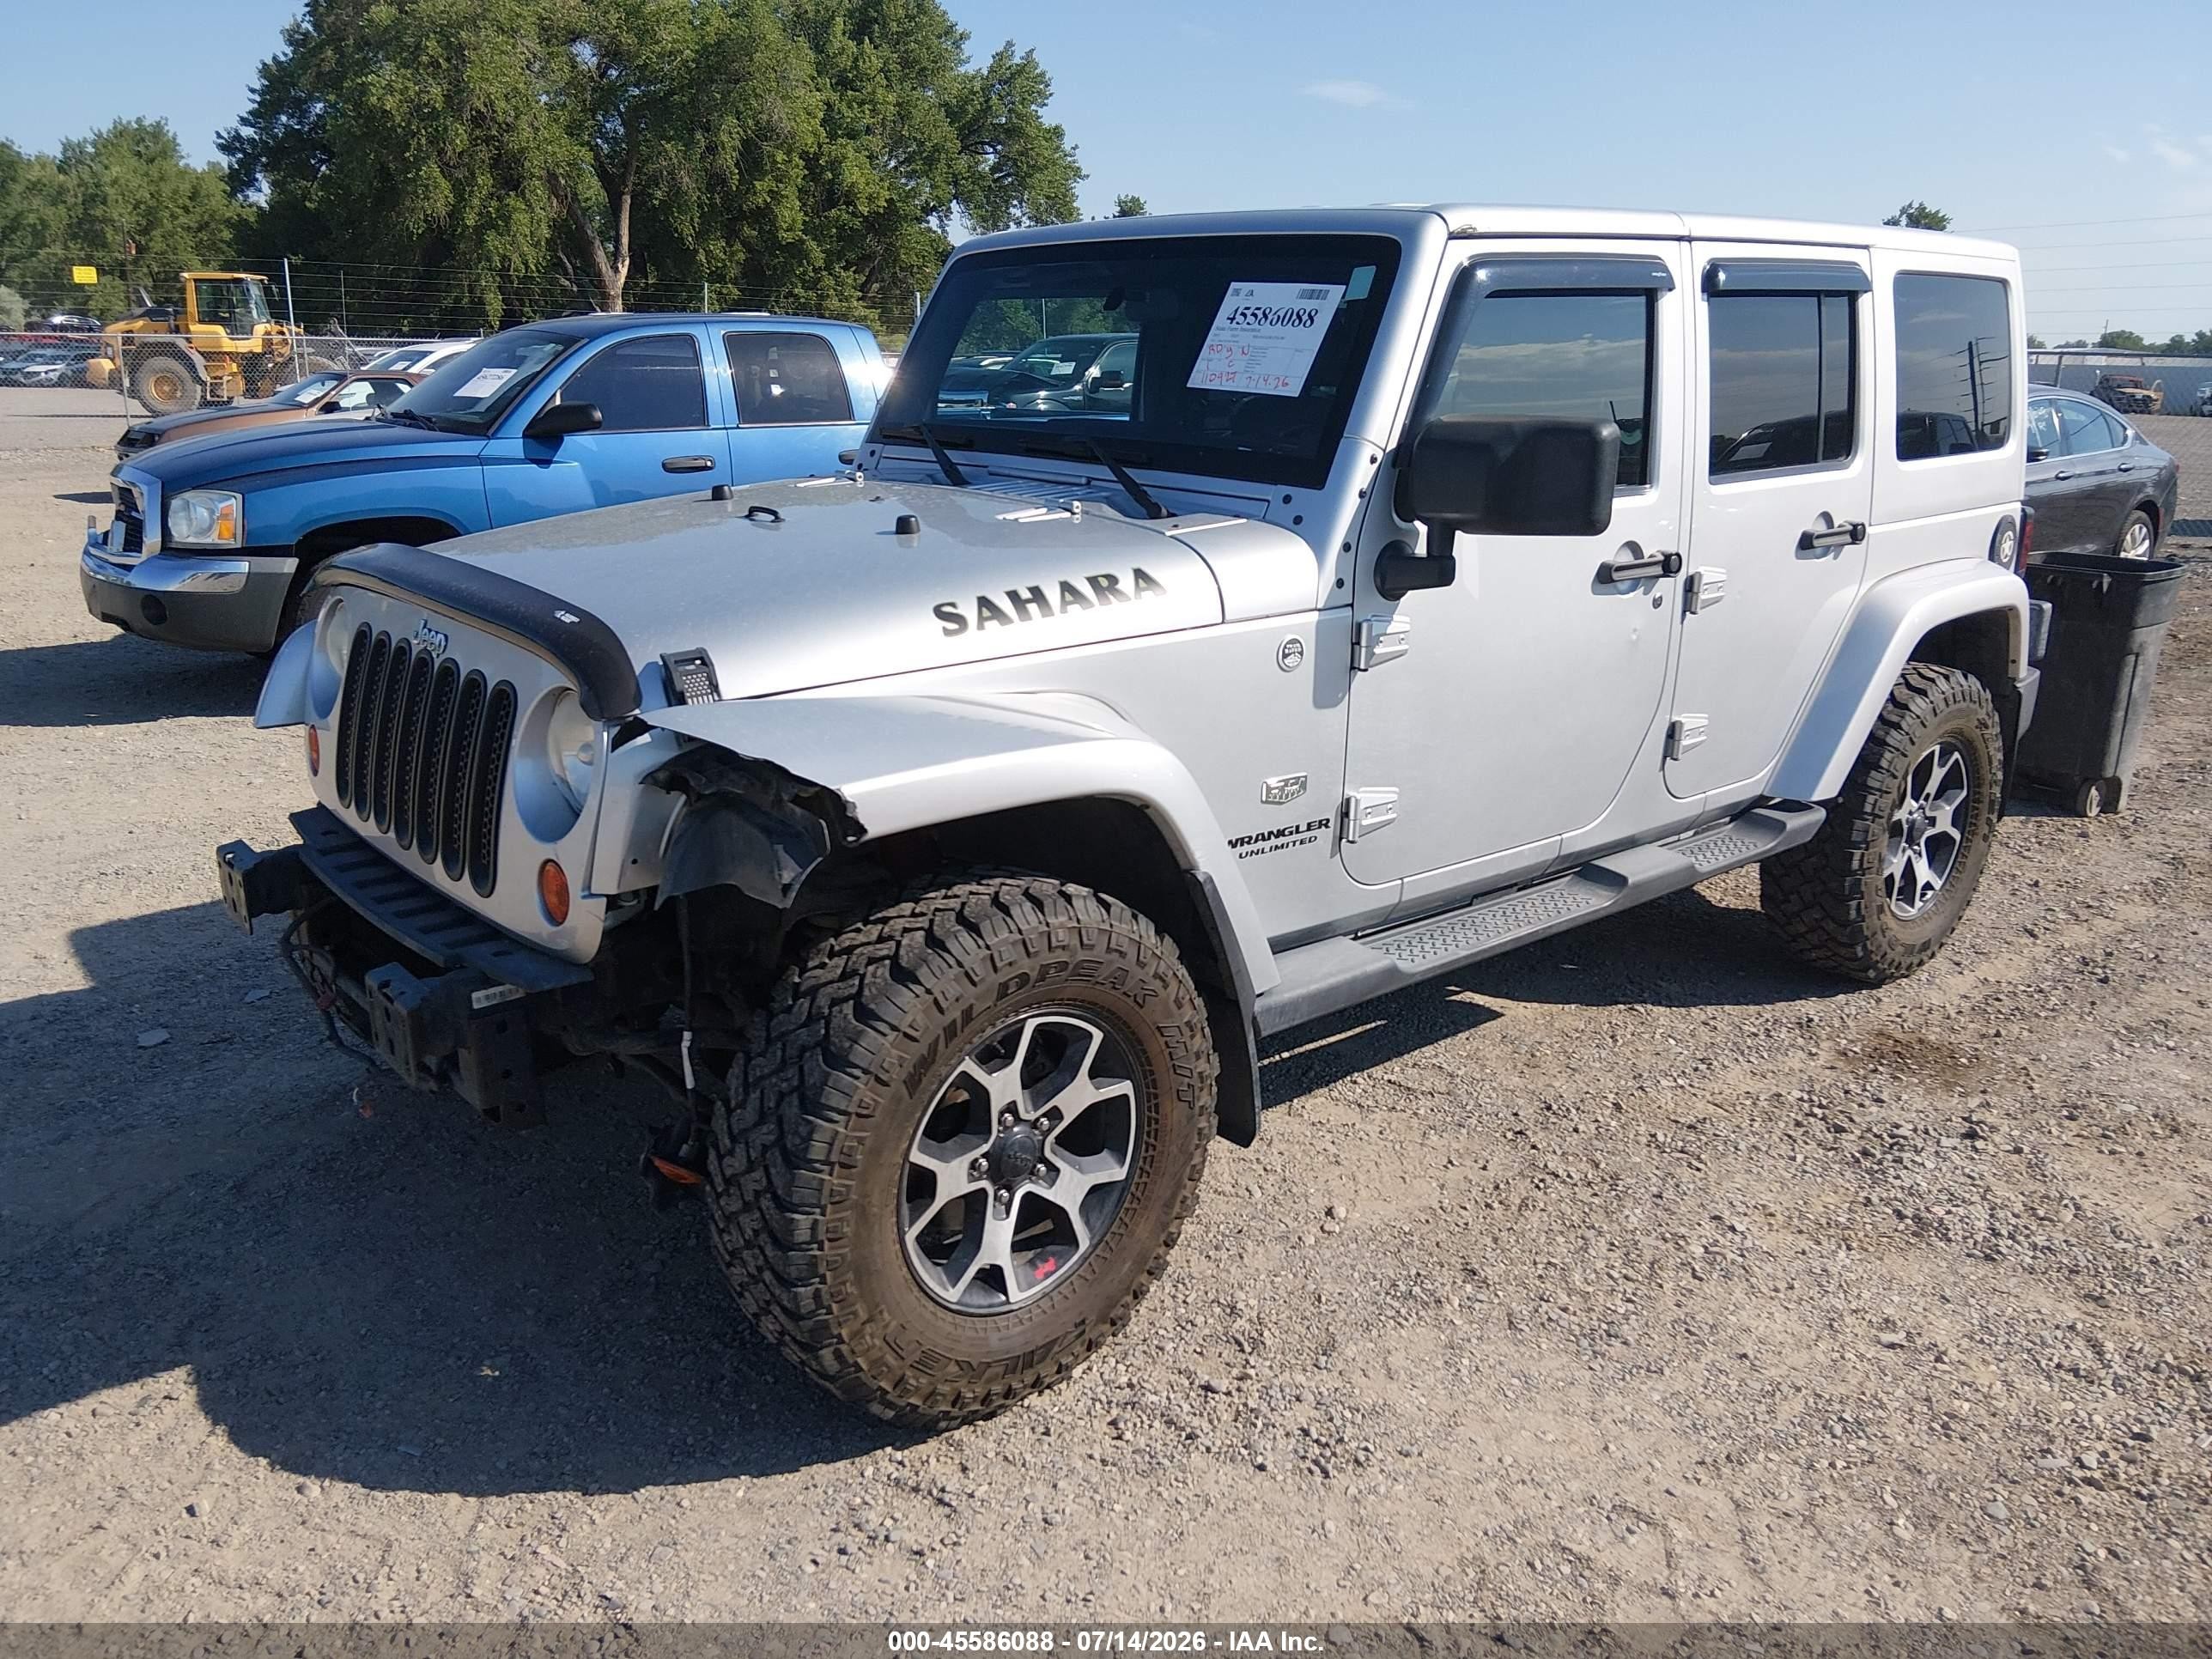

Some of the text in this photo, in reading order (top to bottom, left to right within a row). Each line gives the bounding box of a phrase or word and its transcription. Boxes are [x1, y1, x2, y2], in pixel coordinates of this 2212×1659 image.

[1226, 305, 1319, 329] 45586088
[932, 566, 1168, 638] SAHARA
[412, 618, 449, 659] Jeep
[1237, 836, 1319, 860] UNLIMITED
